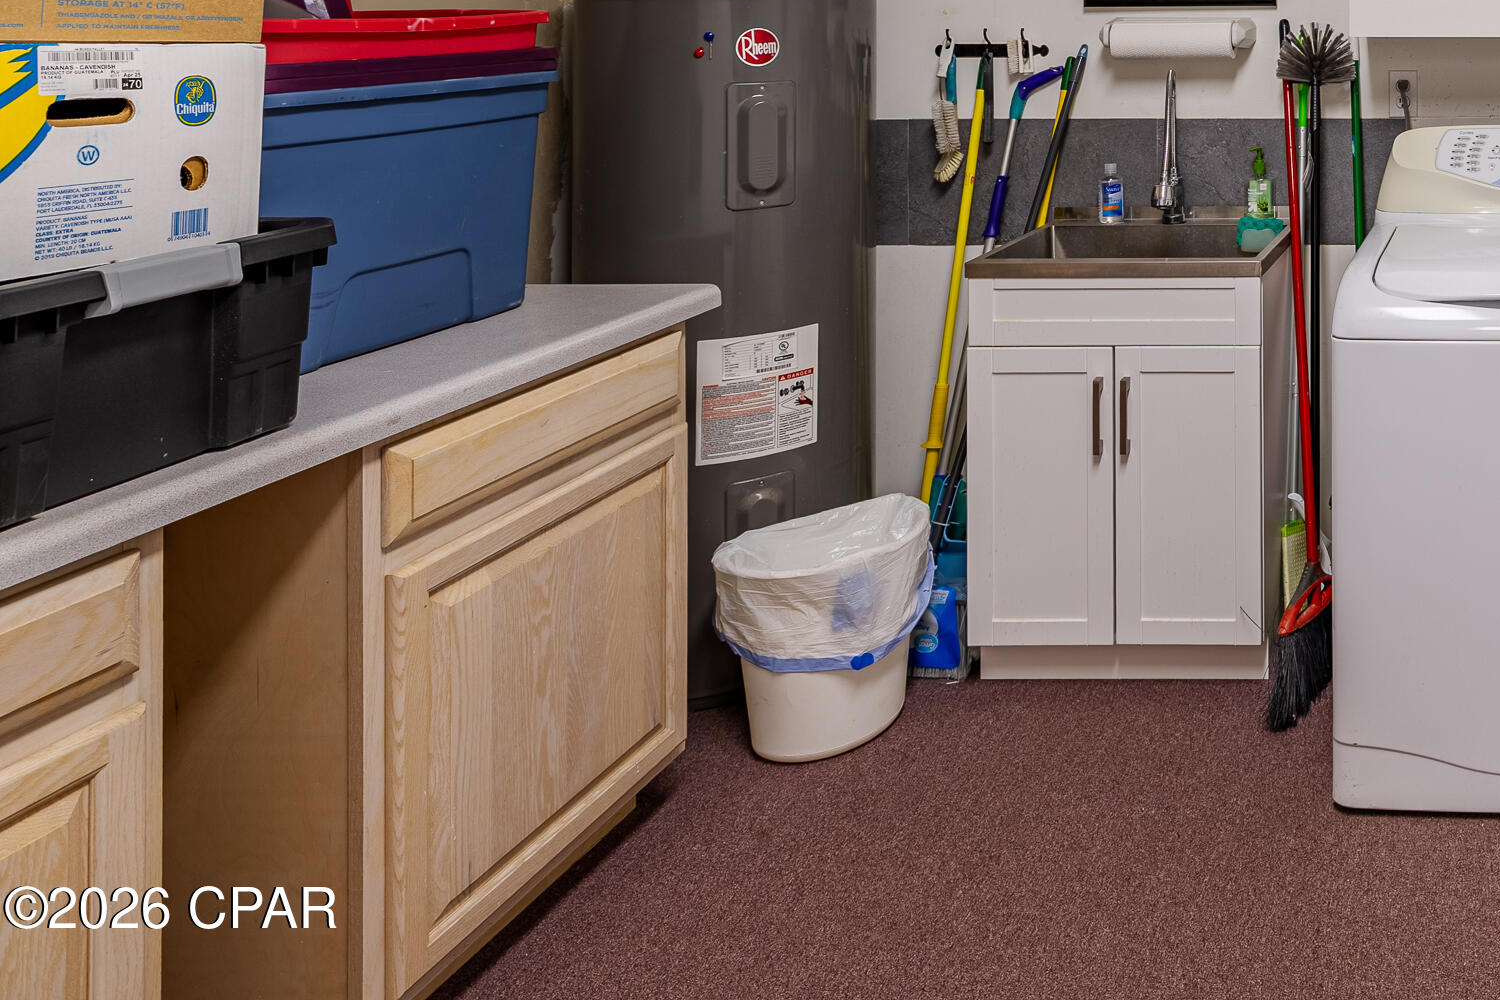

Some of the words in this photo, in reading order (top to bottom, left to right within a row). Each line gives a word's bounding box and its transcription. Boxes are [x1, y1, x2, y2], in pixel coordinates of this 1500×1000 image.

[57, 0, 109, 8] STORAGE
[741, 30, 777, 60] Rheem
[129, 80, 142, 88] 70
[177, 102, 215, 117] Chiquita
[81, 150, 95, 161] W
[90, 228, 121, 236] GUATEMALA
